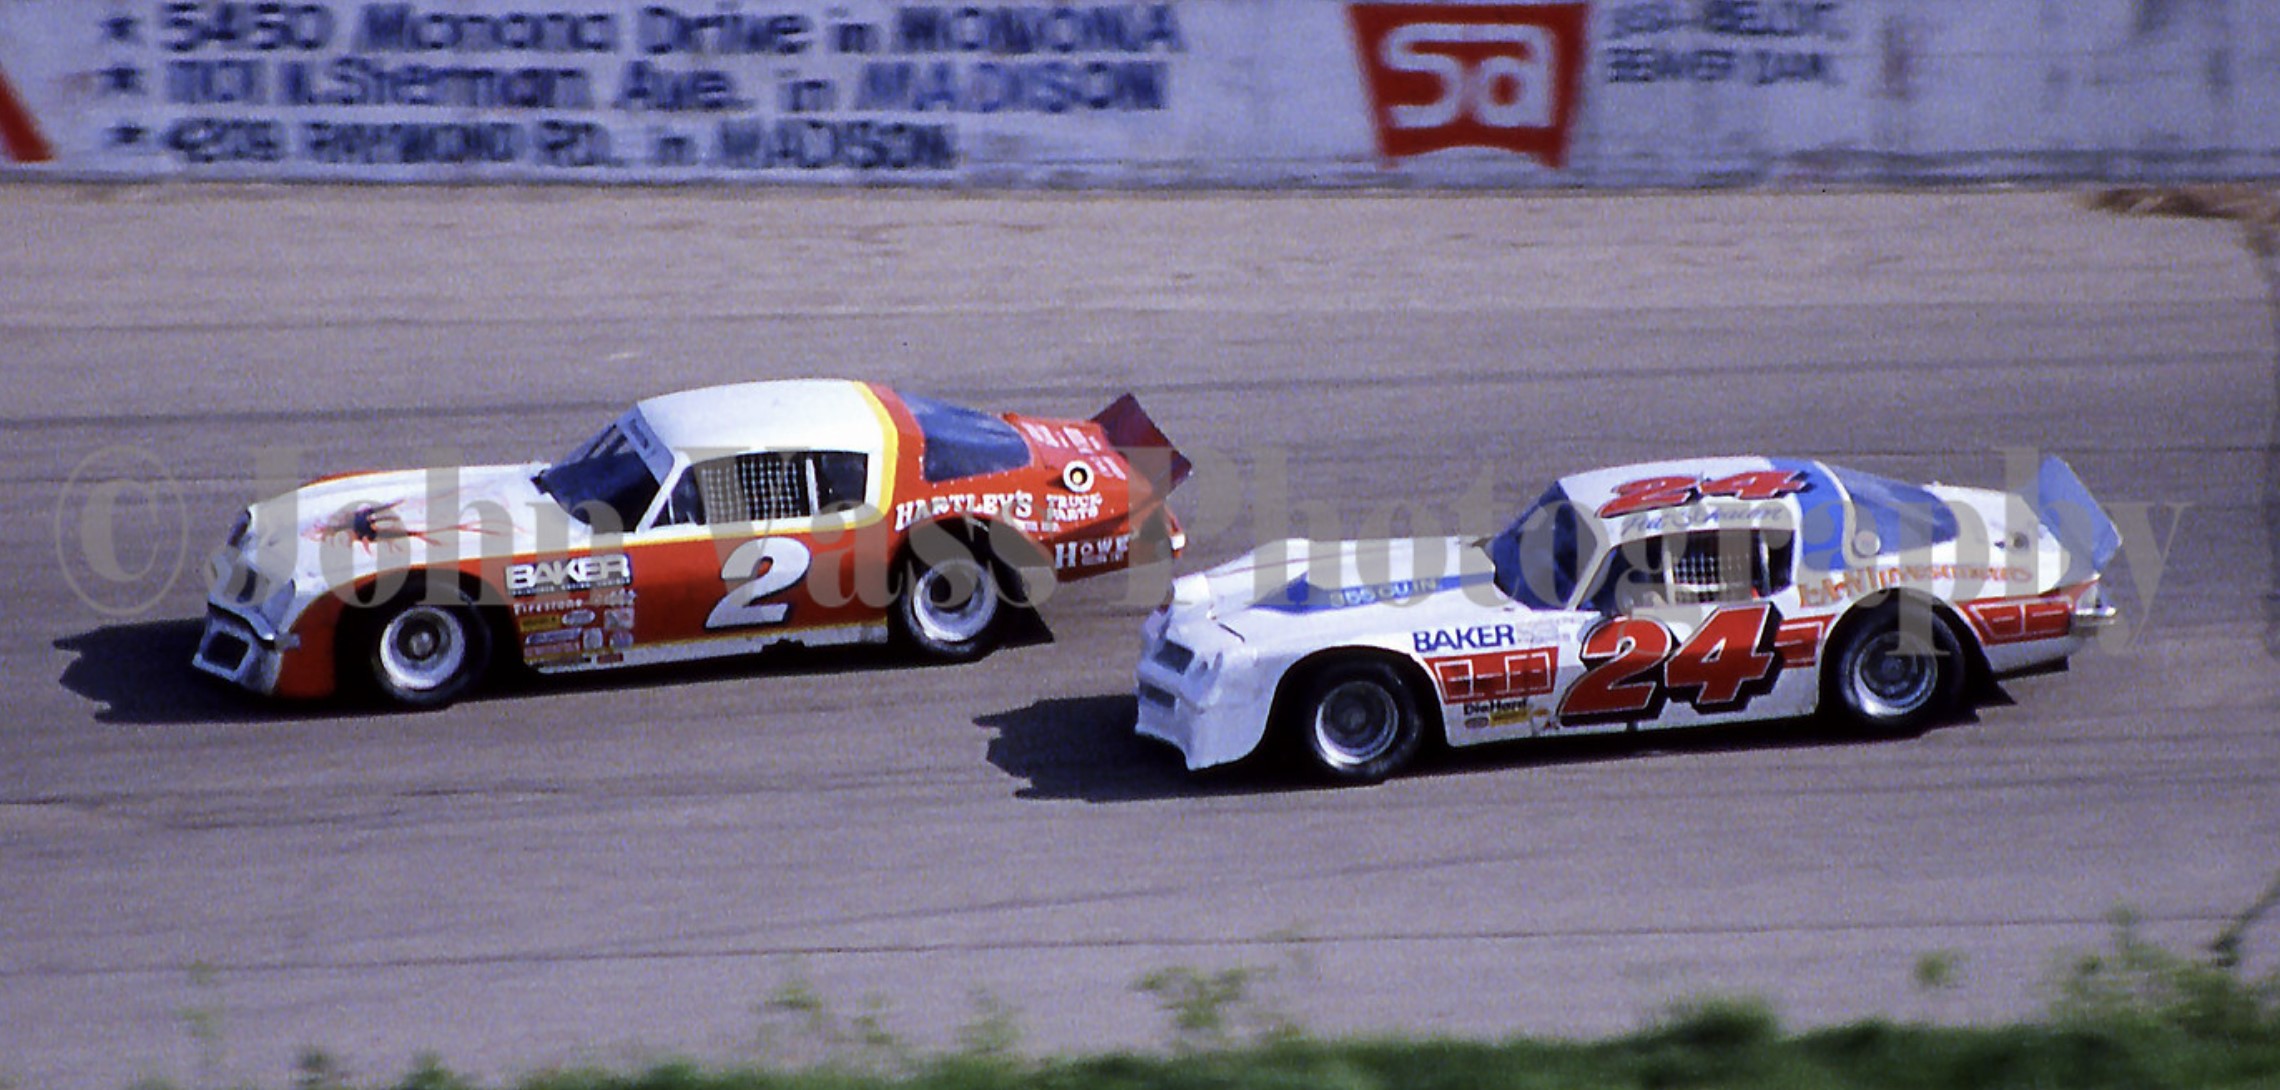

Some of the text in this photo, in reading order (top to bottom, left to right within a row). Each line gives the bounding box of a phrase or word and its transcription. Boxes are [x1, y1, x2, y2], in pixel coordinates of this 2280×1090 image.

[639, 1, 814, 55] Drive
[826, 7, 882, 55] in
[779, 68, 838, 113] in
[854, 61, 1168, 113] MADISON
[714, 119, 959, 170] MADISON
[895, 489, 1034, 532] HARTLEY'S
[1046, 493, 1103, 511] TRUCK
[1595, 469, 1817, 518] 24
[506, 553, 632, 590] BAKER
[704, 537, 812, 634] 2
[1413, 624, 1515, 653] BAKER
[1557, 602, 1784, 727] 24
